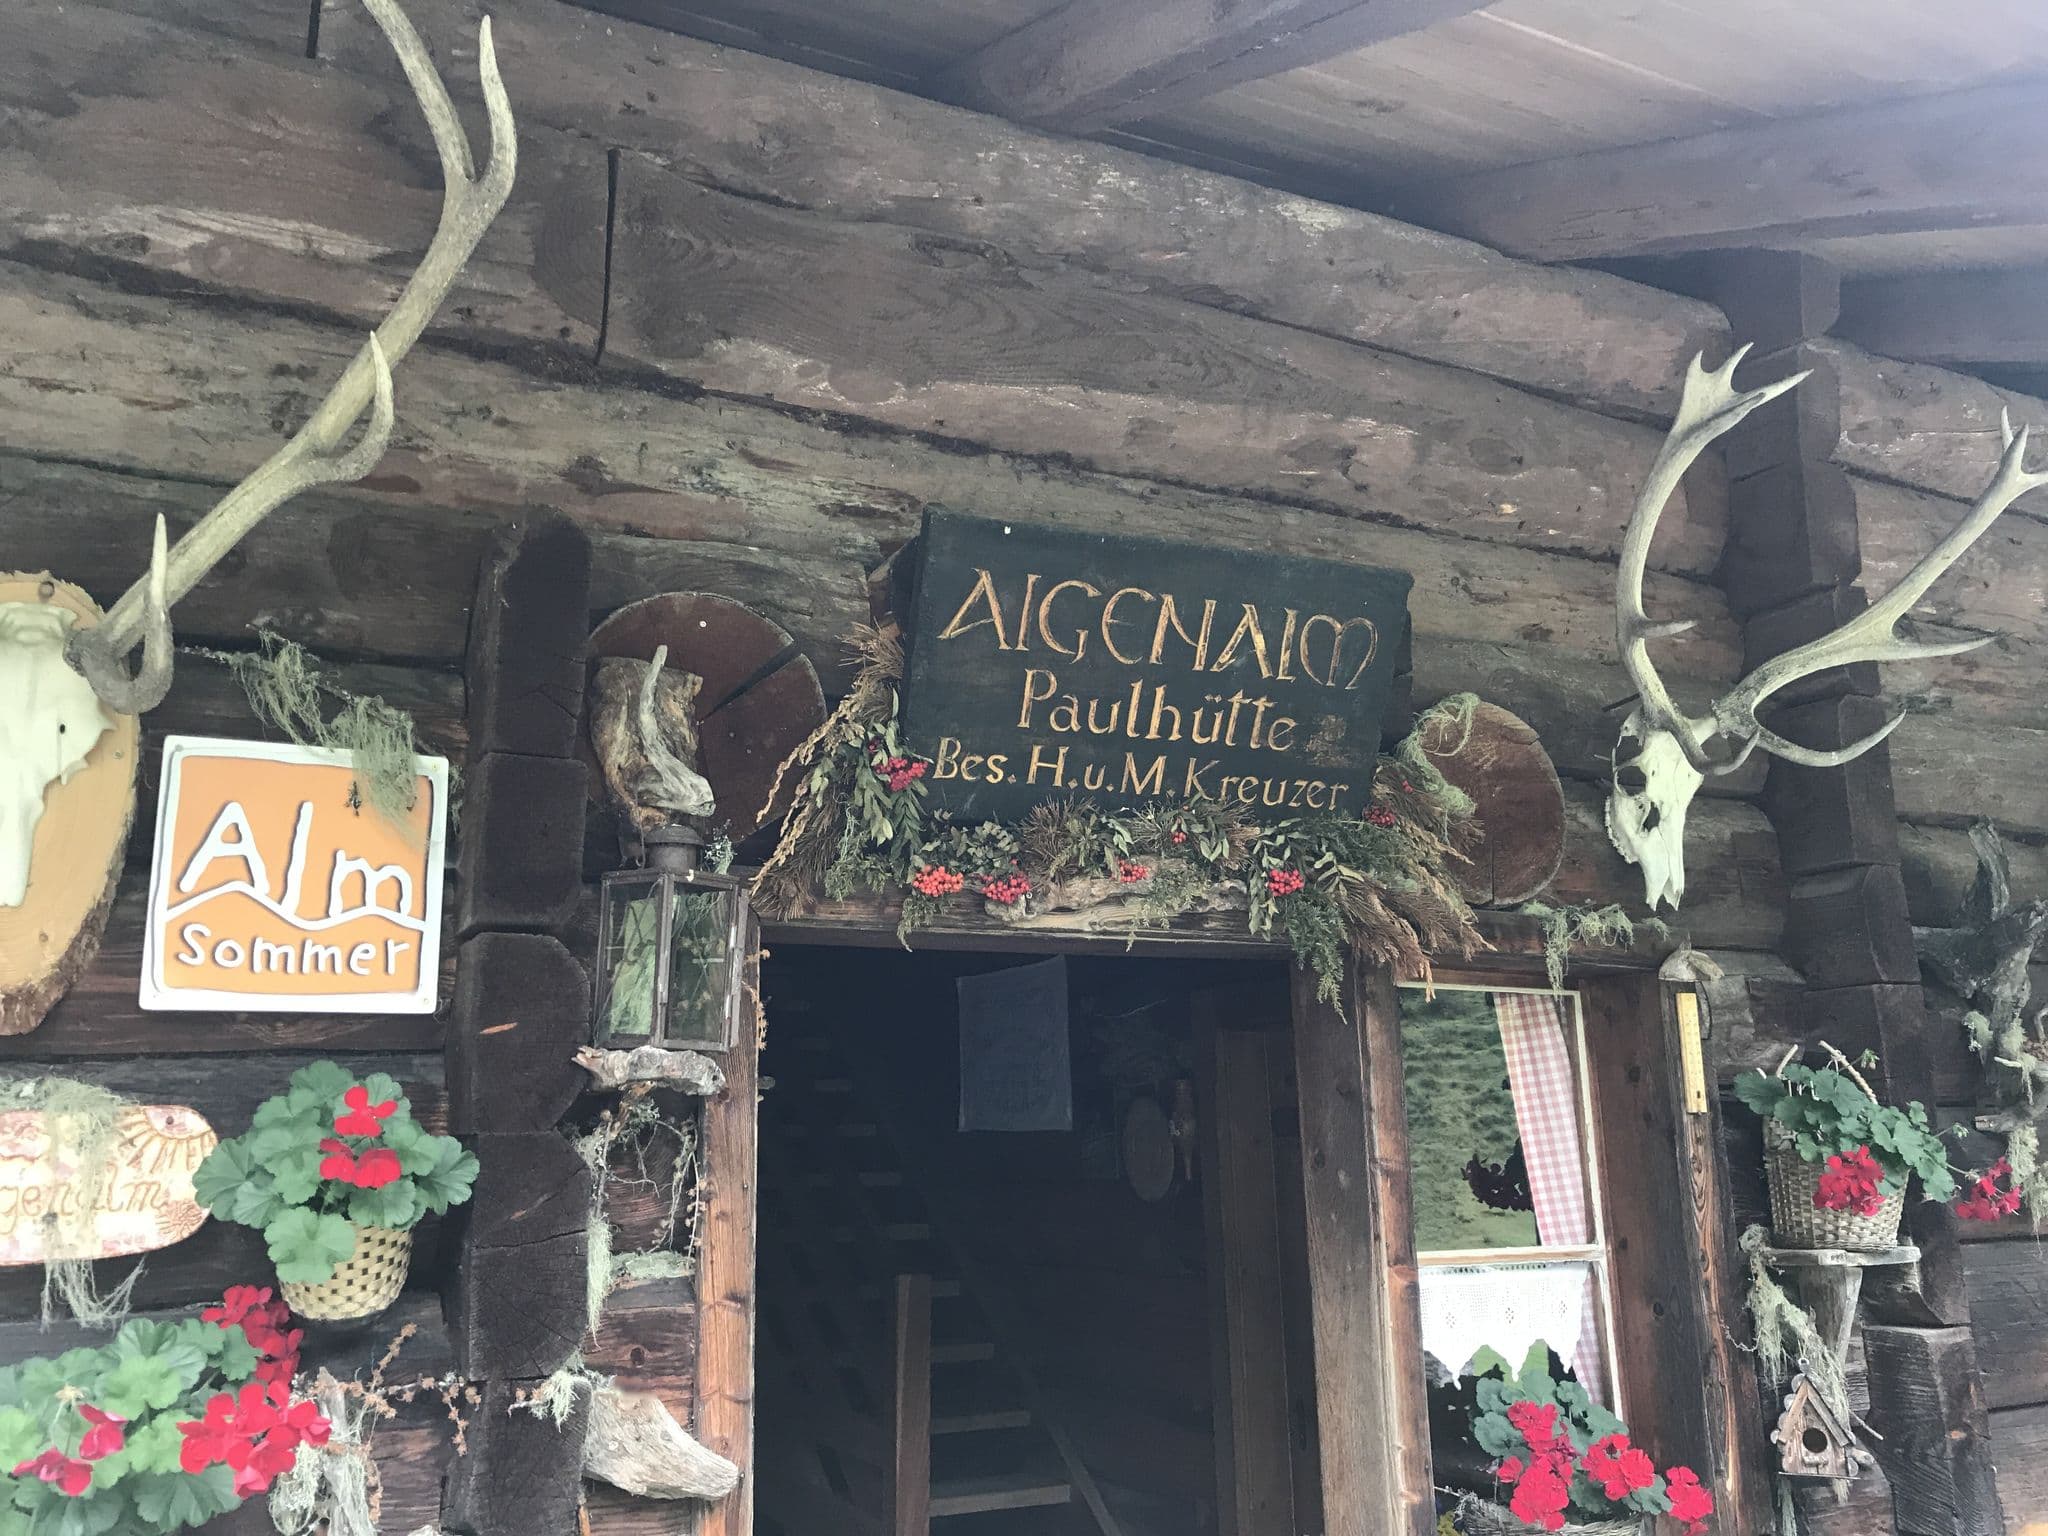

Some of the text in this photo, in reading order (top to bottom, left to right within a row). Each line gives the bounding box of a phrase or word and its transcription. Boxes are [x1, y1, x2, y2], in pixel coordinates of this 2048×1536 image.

[1016, 668, 1299, 751] Paulhütte
[931, 735, 1018, 785] Bes.
[178, 801, 413, 918] Alm
[177, 923, 411, 977] Sommer
